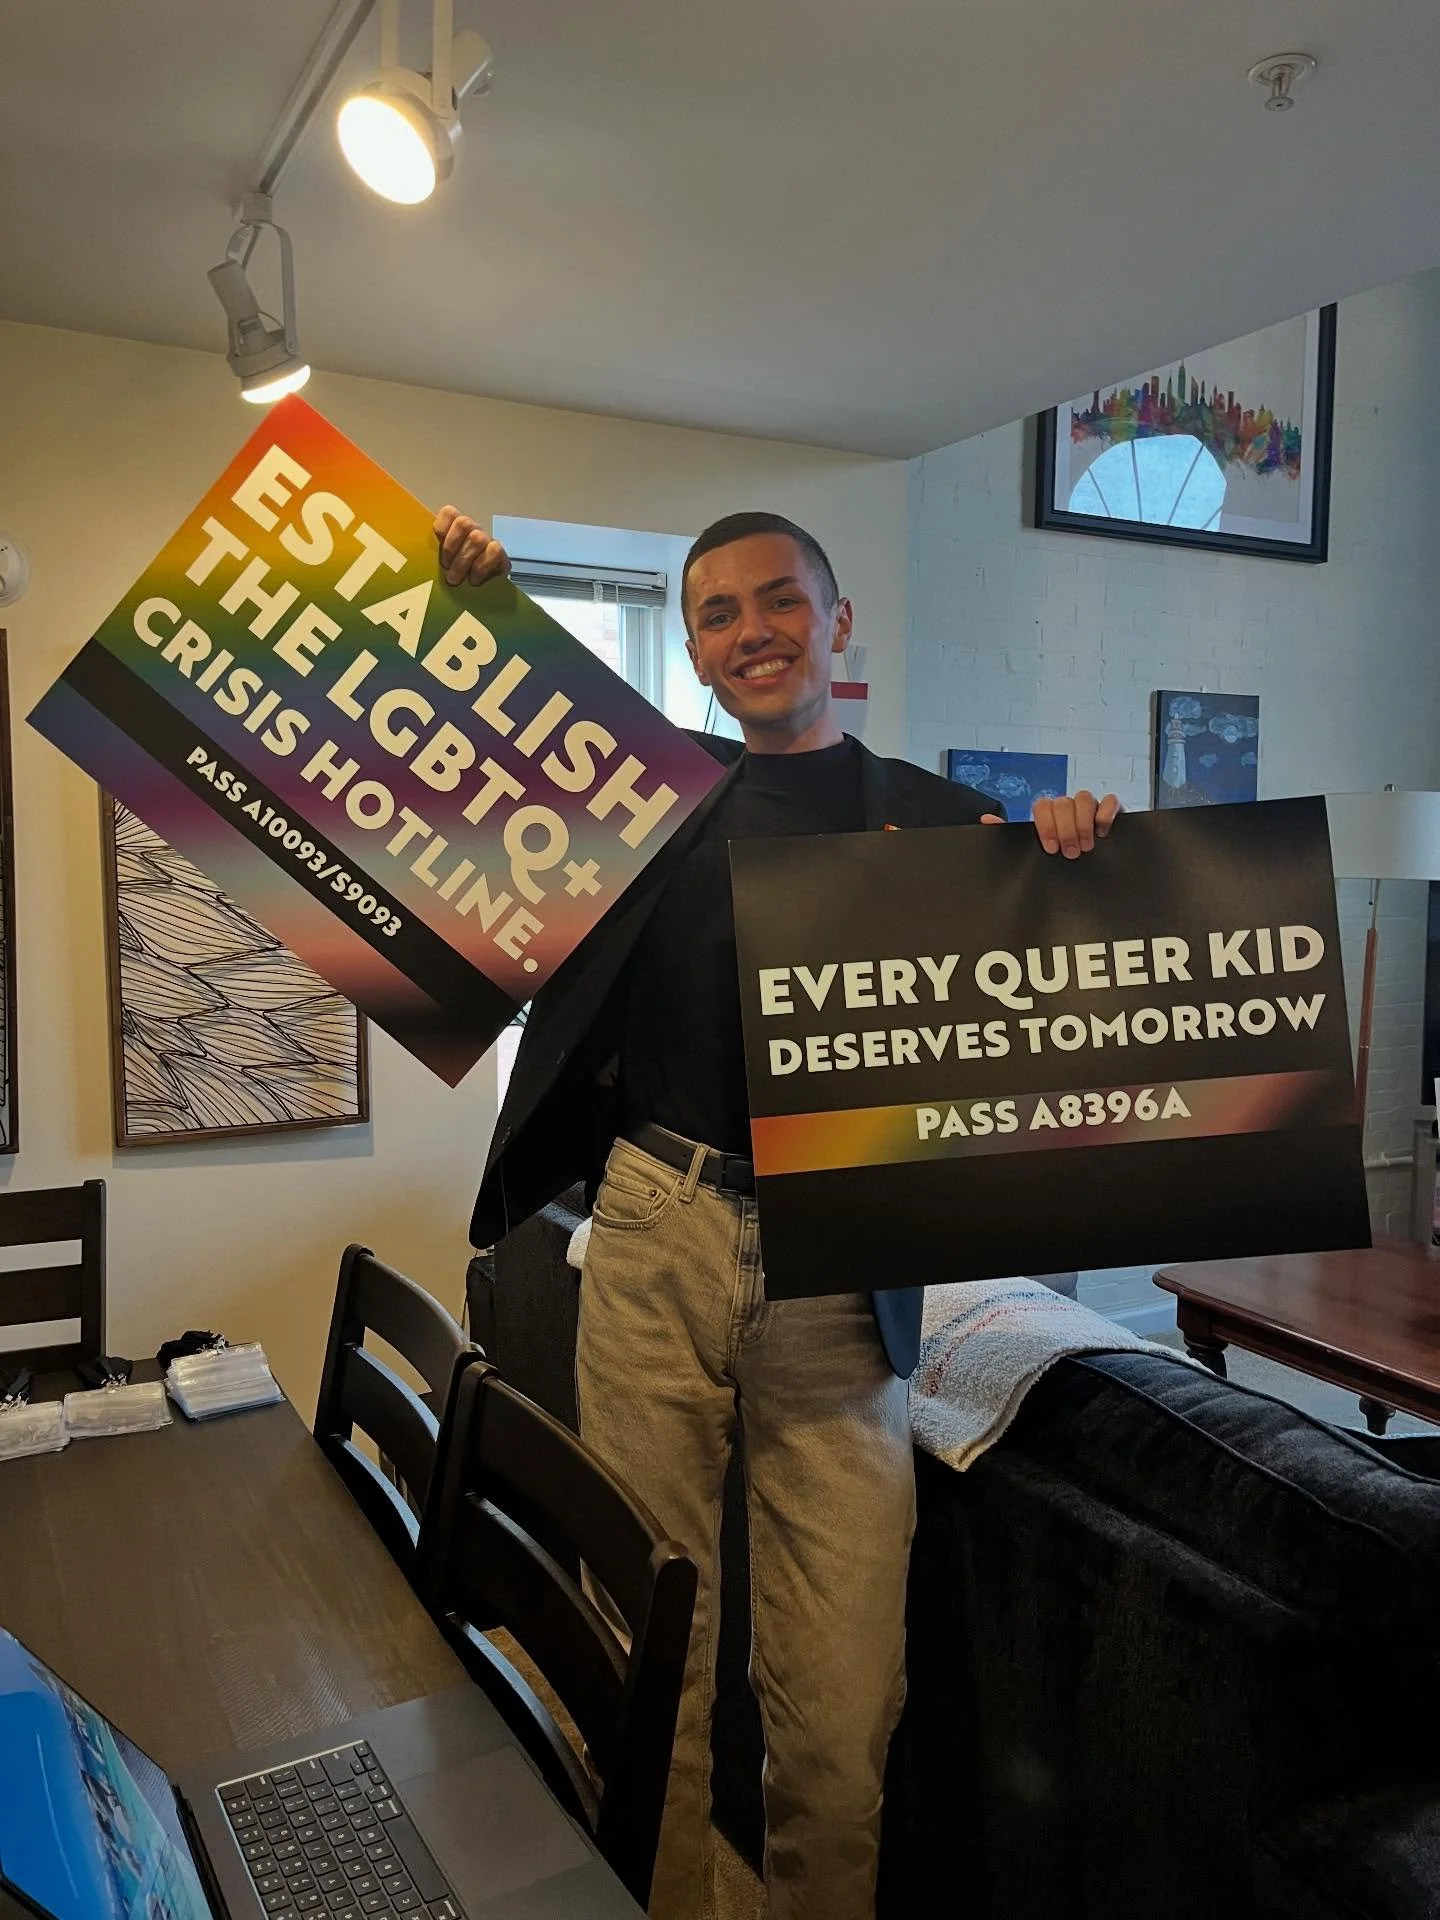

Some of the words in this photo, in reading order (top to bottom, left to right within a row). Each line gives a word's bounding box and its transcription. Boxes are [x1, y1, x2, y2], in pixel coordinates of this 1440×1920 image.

[185, 517, 343, 678] THE
[325, 648, 603, 905] LGBTQ+
[231, 444, 680, 850] ESTABLISH
[133, 597, 312, 757] CRISIS
[299, 739, 545, 973] HOTLINE.
[186, 746, 248, 802] PASS
[242, 799, 402, 937] A10093/S9093
[758, 954, 961, 1016] EVERY
[974, 936, 1193, 1011] QUEER
[1208, 925, 1325, 979] KID
[768, 1020, 1011, 1076] DESERVES
[1019, 993, 1326, 1054] TOMORROW
[916, 1102, 1019, 1140] PASS
[1029, 1086, 1192, 1131] A8396A
